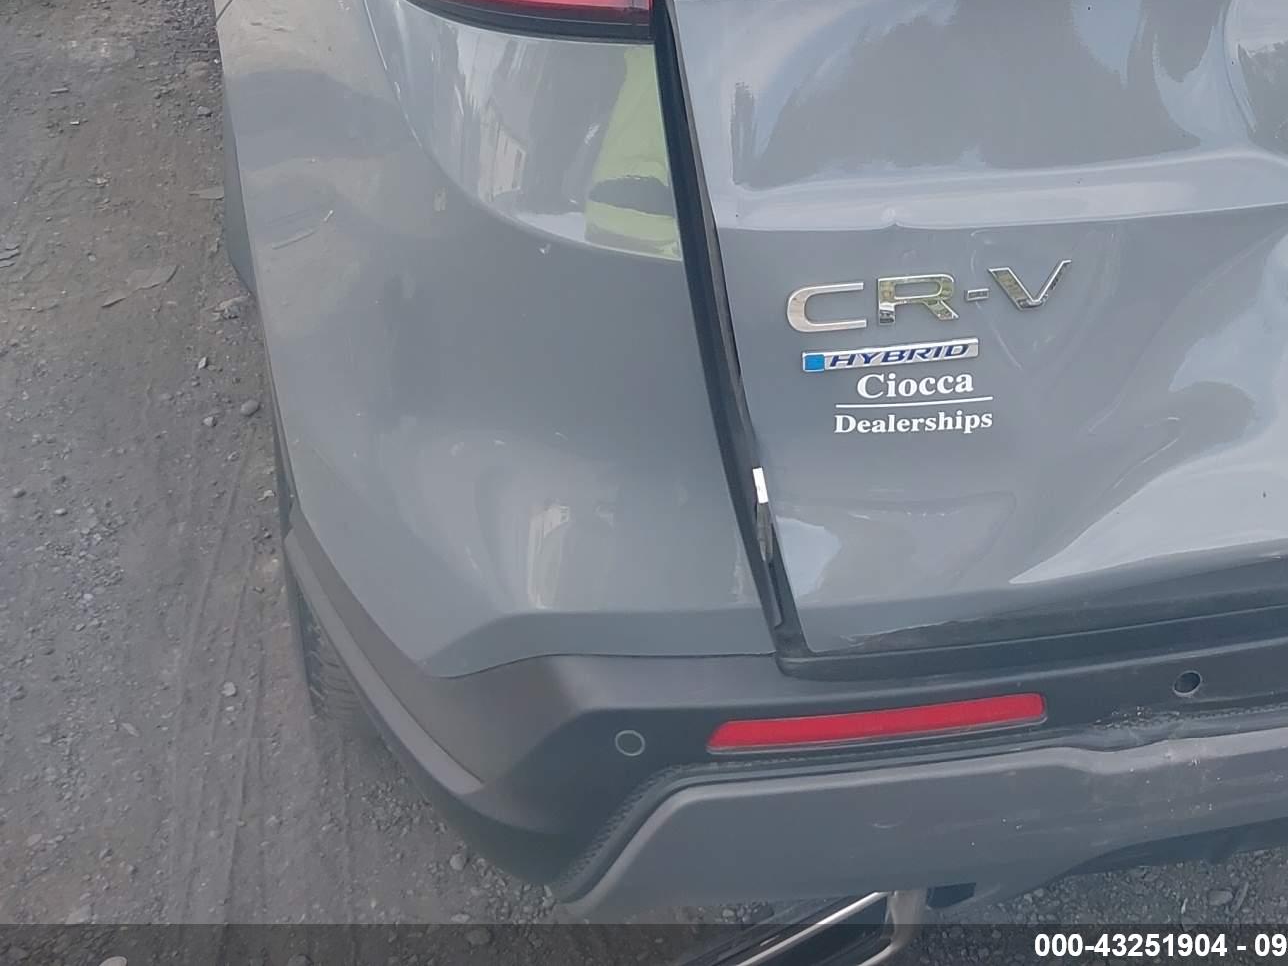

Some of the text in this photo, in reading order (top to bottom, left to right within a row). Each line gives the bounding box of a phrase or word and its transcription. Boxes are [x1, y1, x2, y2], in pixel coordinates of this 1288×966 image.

[786, 259, 1072, 333] CR-V
[829, 343, 970, 368] HYBRID
[857, 373, 974, 399] Ciocca
[834, 410, 993, 434] Dealerships
